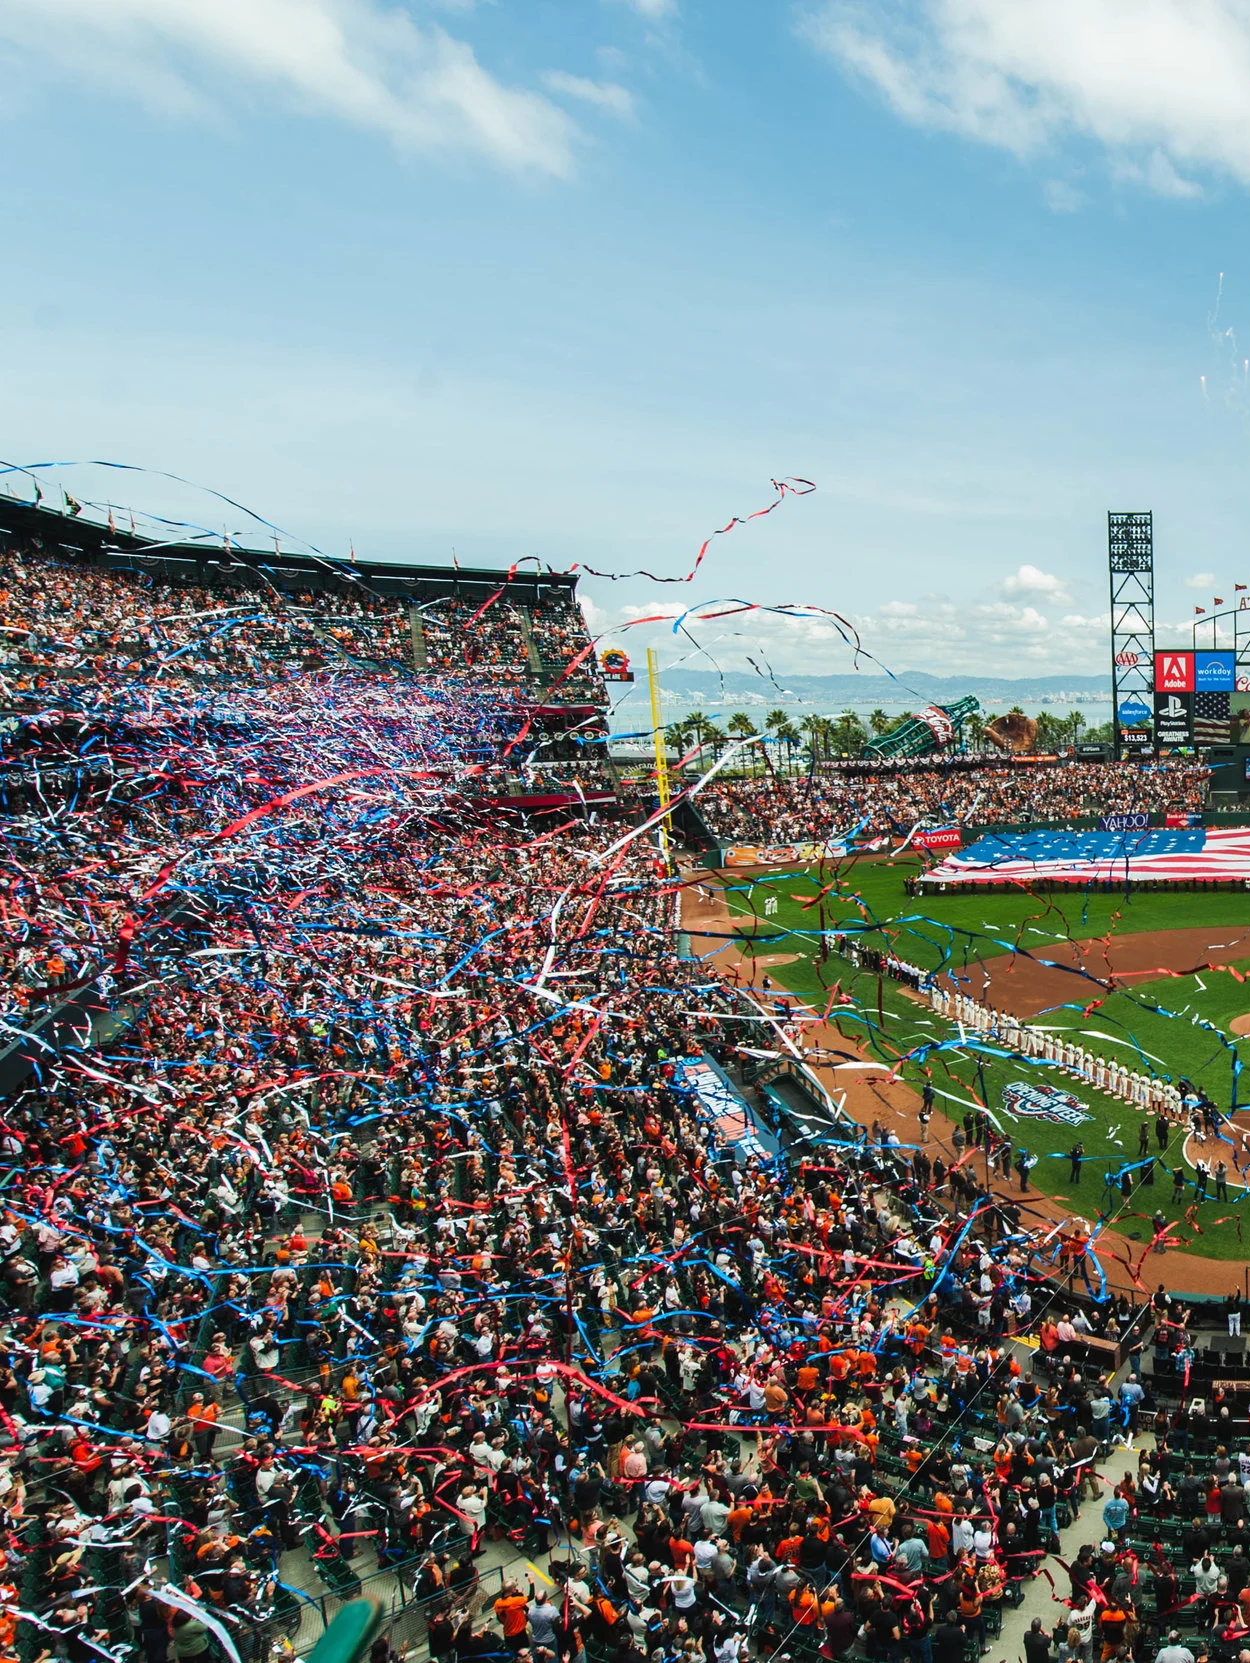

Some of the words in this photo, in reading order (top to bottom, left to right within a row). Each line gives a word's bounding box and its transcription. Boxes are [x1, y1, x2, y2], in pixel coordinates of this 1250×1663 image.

[1198, 668, 1231, 677] workday
[1164, 680, 1186, 688] Adobe
[1124, 734, 1147, 742] $13,523
[1102, 814, 1149, 829] YAHOO!
[925, 834, 960, 843] TOYOTA
[1005, 1081, 1058, 1108] OPENING
[1049, 1103, 1087, 1125] WEEK
